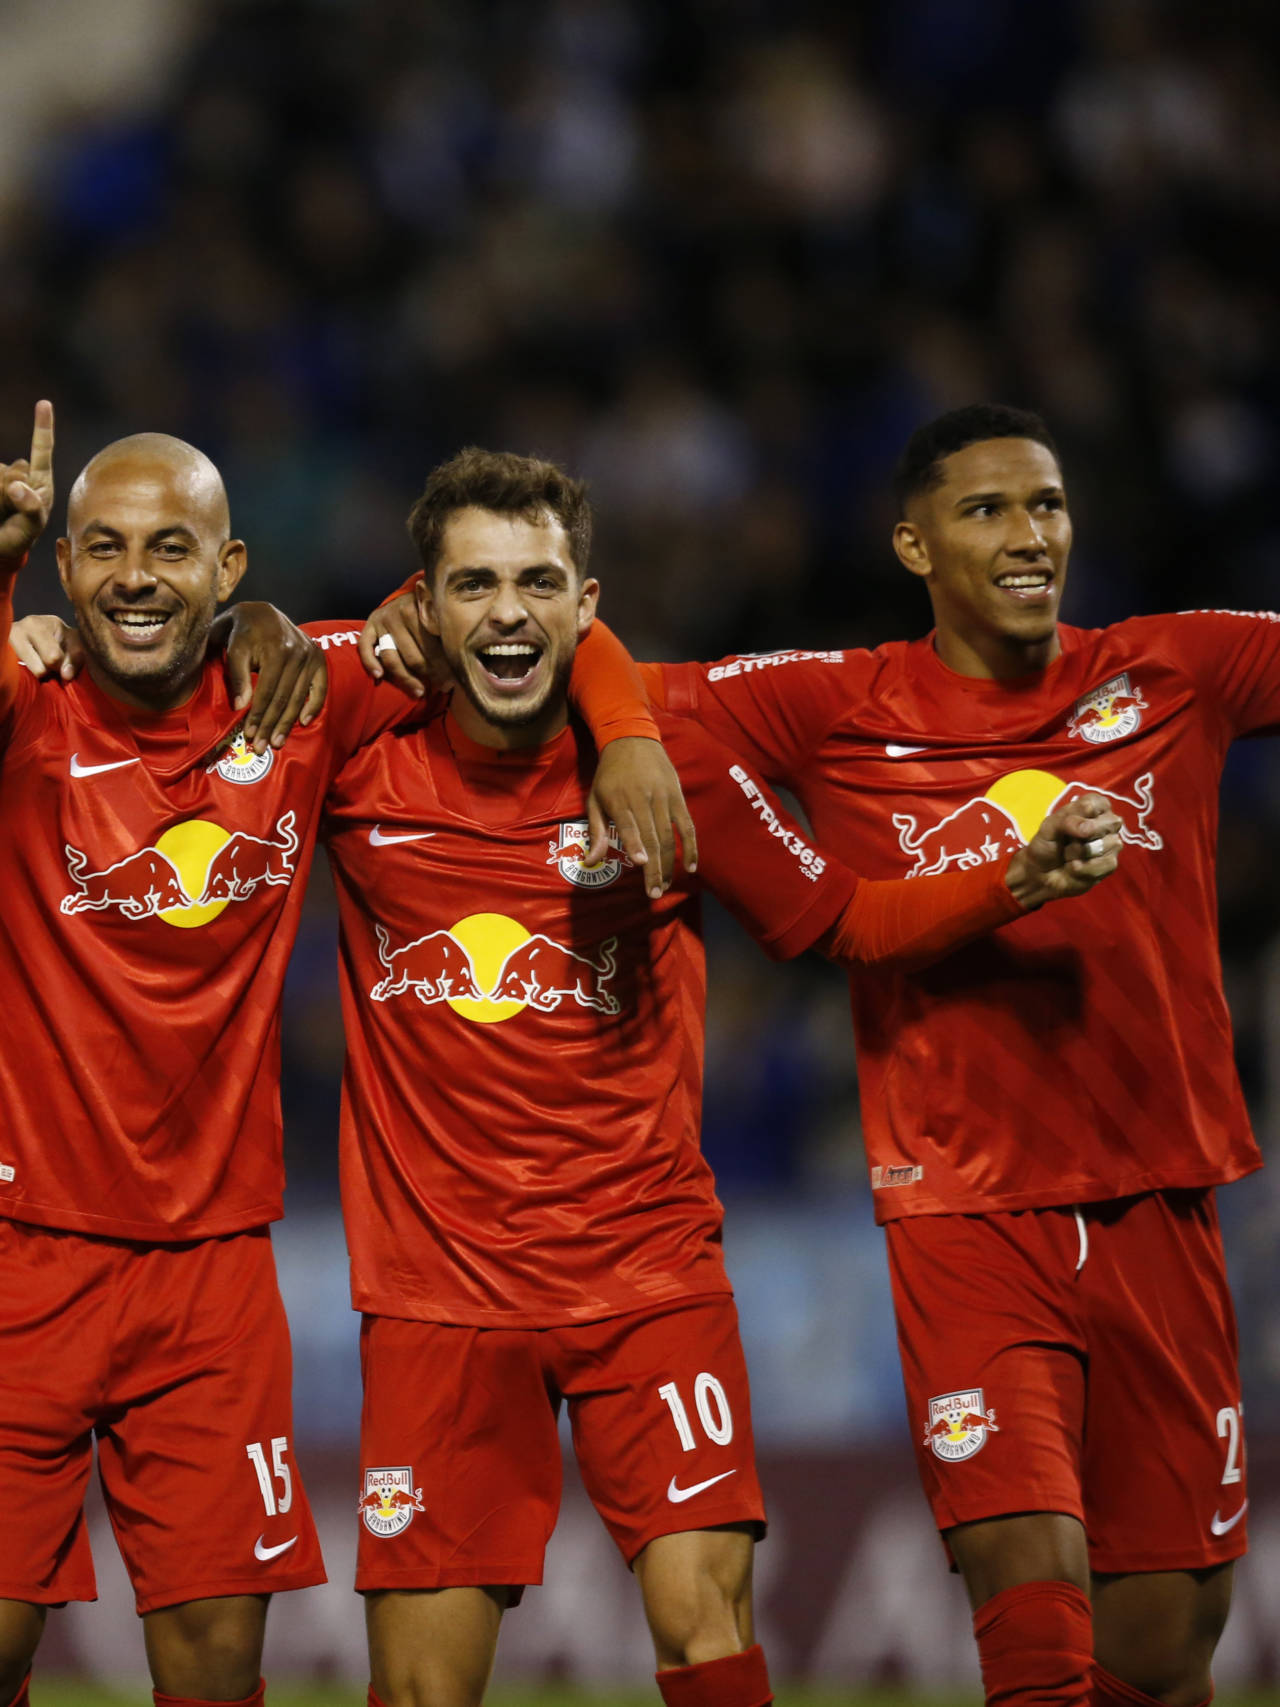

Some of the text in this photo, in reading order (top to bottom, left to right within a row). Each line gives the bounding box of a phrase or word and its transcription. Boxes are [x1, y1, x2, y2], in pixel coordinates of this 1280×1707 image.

[707, 649, 844, 682] BETPIX365
[224, 752, 268, 777] BRAGANTINO
[728, 764, 827, 875] BETPIX365
[565, 864, 616, 884] BRAGANTINO
[798, 865, 819, 882] .COM
[657, 1371, 733, 1452] 10
[245, 1436, 293, 1517] 15
[367, 1511, 407, 1532] BRAGANTINO
